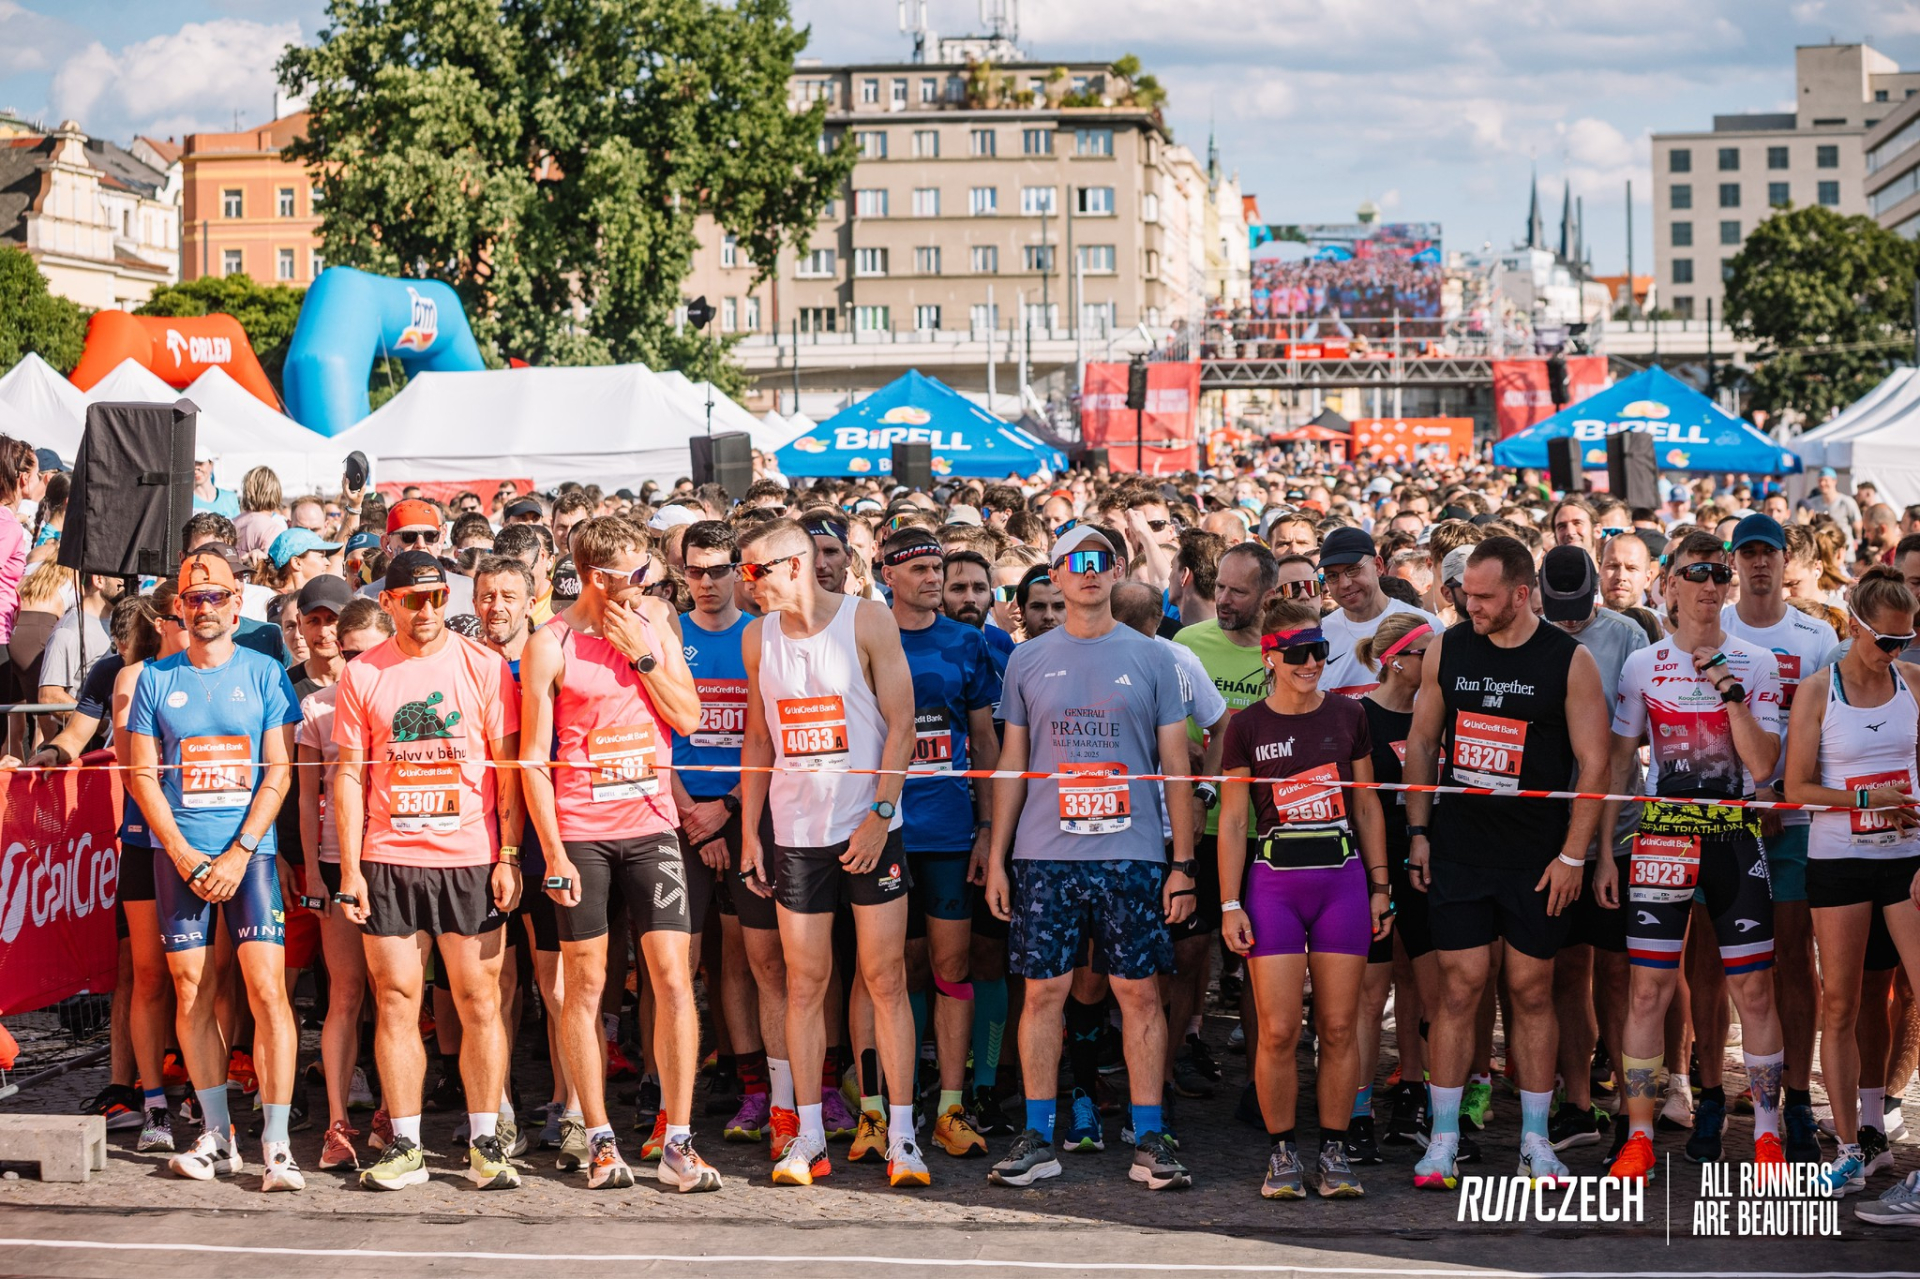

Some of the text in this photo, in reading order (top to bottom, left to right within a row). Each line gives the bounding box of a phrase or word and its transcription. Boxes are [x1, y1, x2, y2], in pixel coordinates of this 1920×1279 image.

[189, 336, 232, 364] ORLEN
[1794, 622, 1814, 632] CRAFT
[1654, 663, 1679, 671] EJOT
[1455, 676, 1535, 695] Run Together.
[791, 704, 837, 714] UniCredit Bank
[1064, 708, 1105, 718] GENERALI
[699, 708, 744, 730] 2501
[926, 714, 943, 723] Bank
[1051, 721, 1120, 737] PRAGUE
[1471, 721, 1519, 736] UniCredit Bank
[603, 731, 649, 744] UniCredit Bank
[787, 727, 844, 752] 4033 A
[1053, 738, 1120, 749] HALF MARATHON
[196, 743, 243, 752] UniCredit Bank
[425, 751, 433, 759] v
[437, 747, 466, 760] běhu
[940, 745, 947, 757] A
[1458, 743, 1509, 771] 3320
[1508, 761, 1515, 773] A
[190, 766, 246, 789] 2734 A
[406, 769, 435, 777] UniCredit
[397, 791, 454, 813] 3307 A
[1065, 793, 1125, 816] 3329 A
[1286, 797, 1333, 820] 2591
[1332, 804, 1340, 816] A
[1671, 822, 1743, 834] TRIATHLON
[1646, 838, 1676, 847] UniCredit
[1635, 861, 1692, 885] 3923 A
